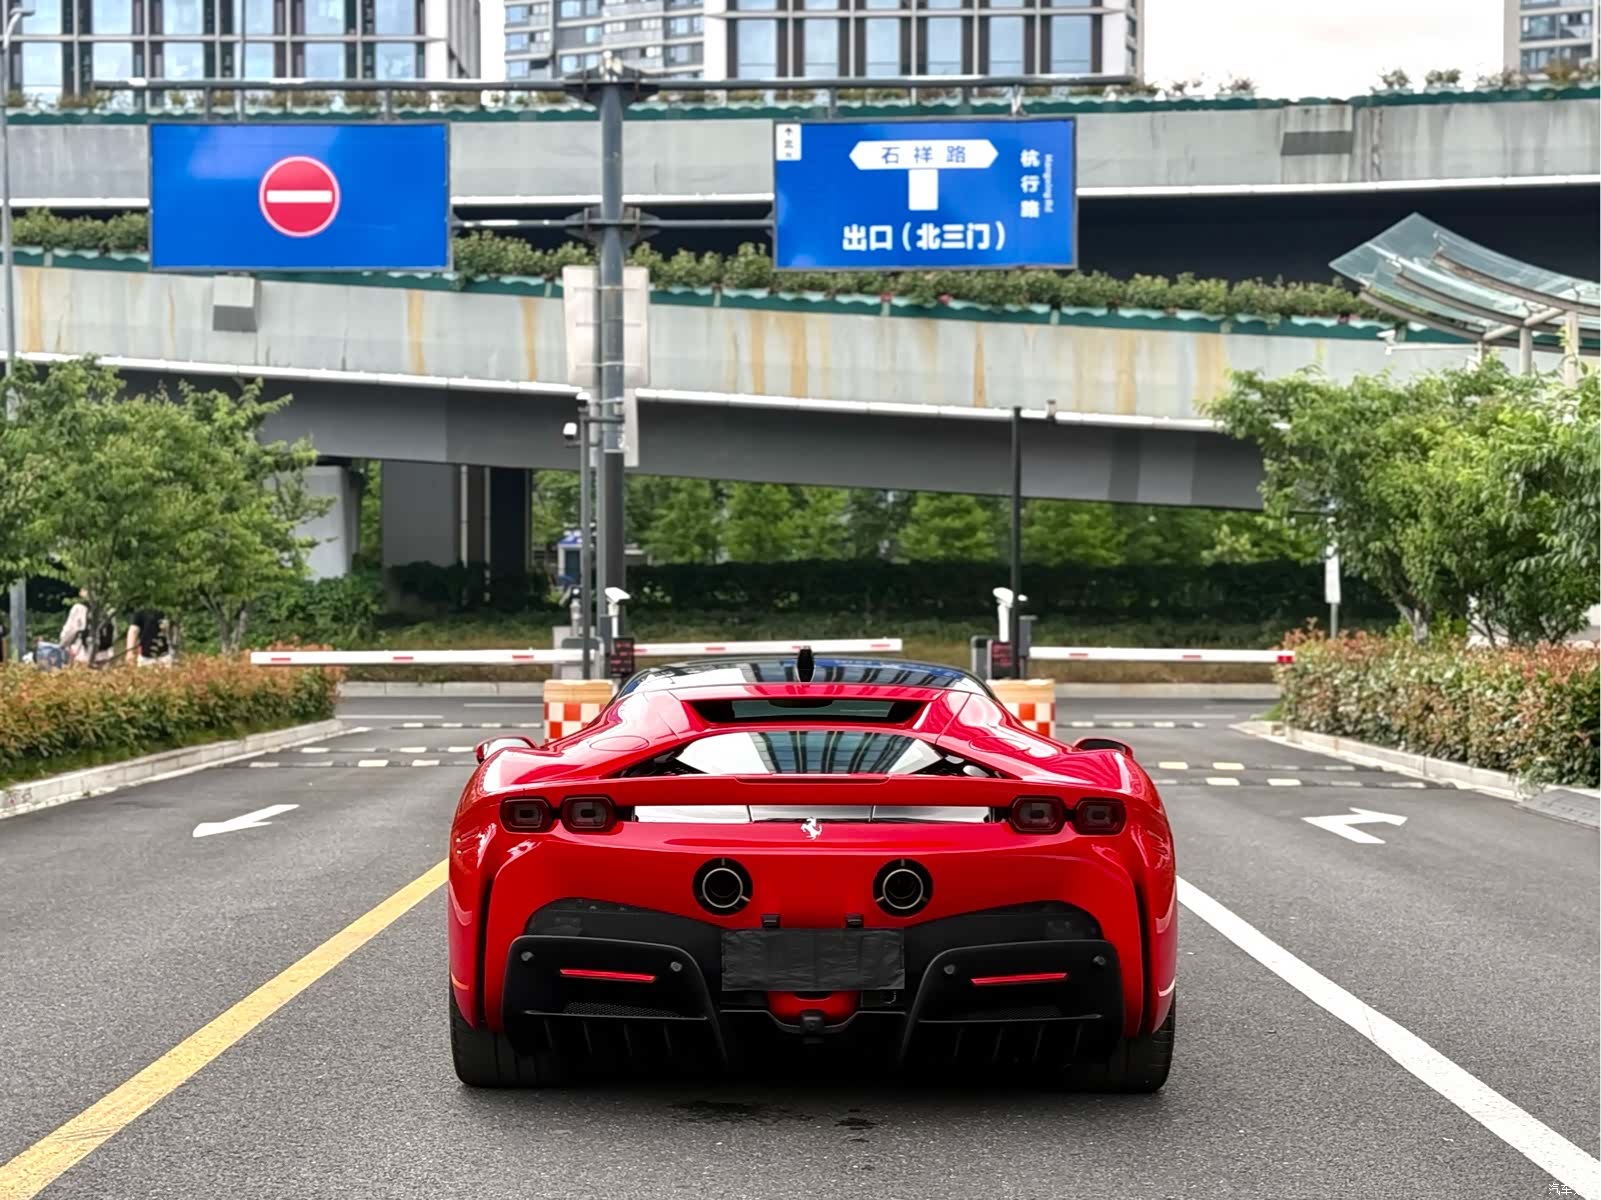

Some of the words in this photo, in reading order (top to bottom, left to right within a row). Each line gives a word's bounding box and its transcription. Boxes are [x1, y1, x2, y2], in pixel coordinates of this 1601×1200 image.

[881, 146, 967, 164] 石祥路
[1020, 149, 1041, 219] 杭行路
